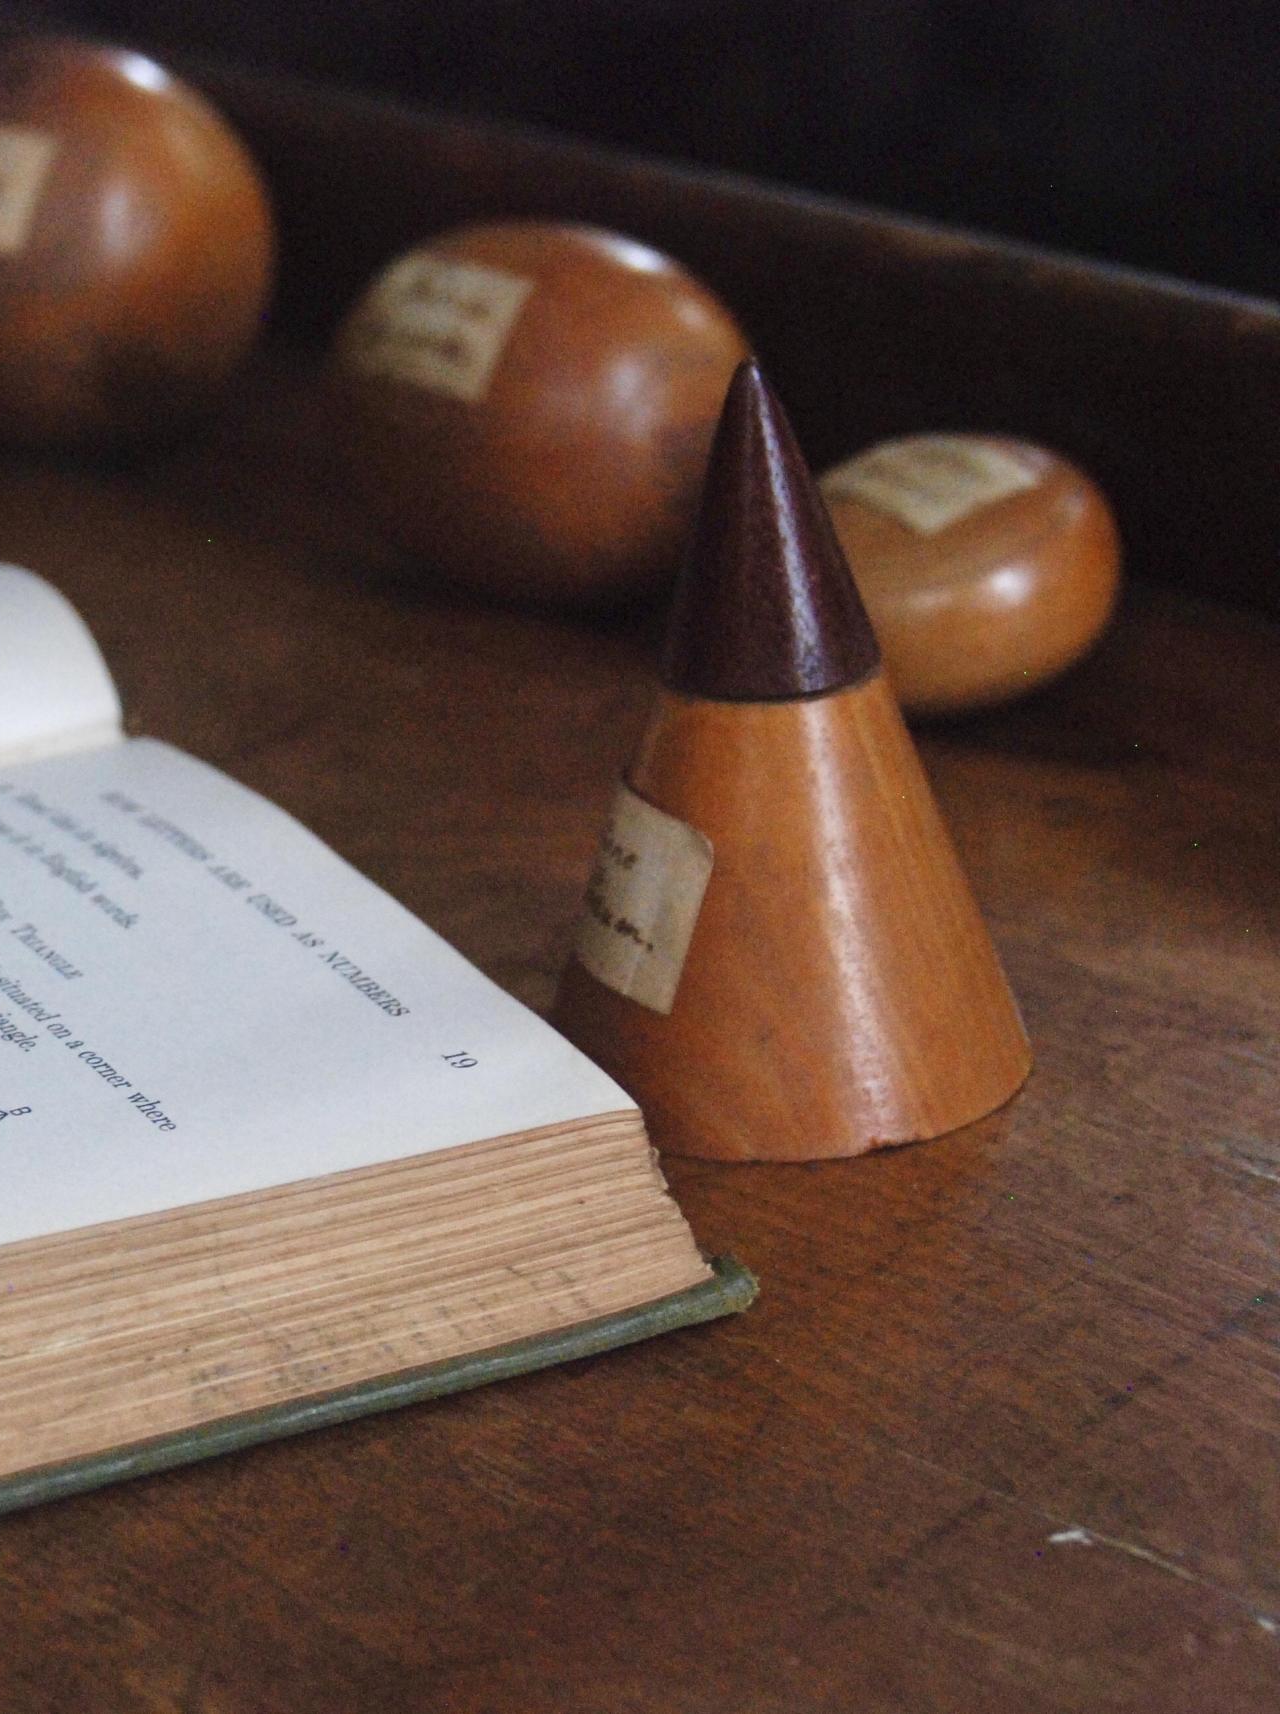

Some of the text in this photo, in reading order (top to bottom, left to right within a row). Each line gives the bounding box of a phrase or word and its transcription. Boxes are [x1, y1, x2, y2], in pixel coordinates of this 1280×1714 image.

[290, 931, 325, 948] AS
[319, 951, 411, 1018] NUMBERS
[46, 1020, 73, 1040] on
[64, 1039, 85, 1050] a
[78, 1049, 132, 1089] corner
[127, 1090, 177, 1132] where
[440, 1049, 478, 1070] 19
[8, 1105, 33, 1117] B
